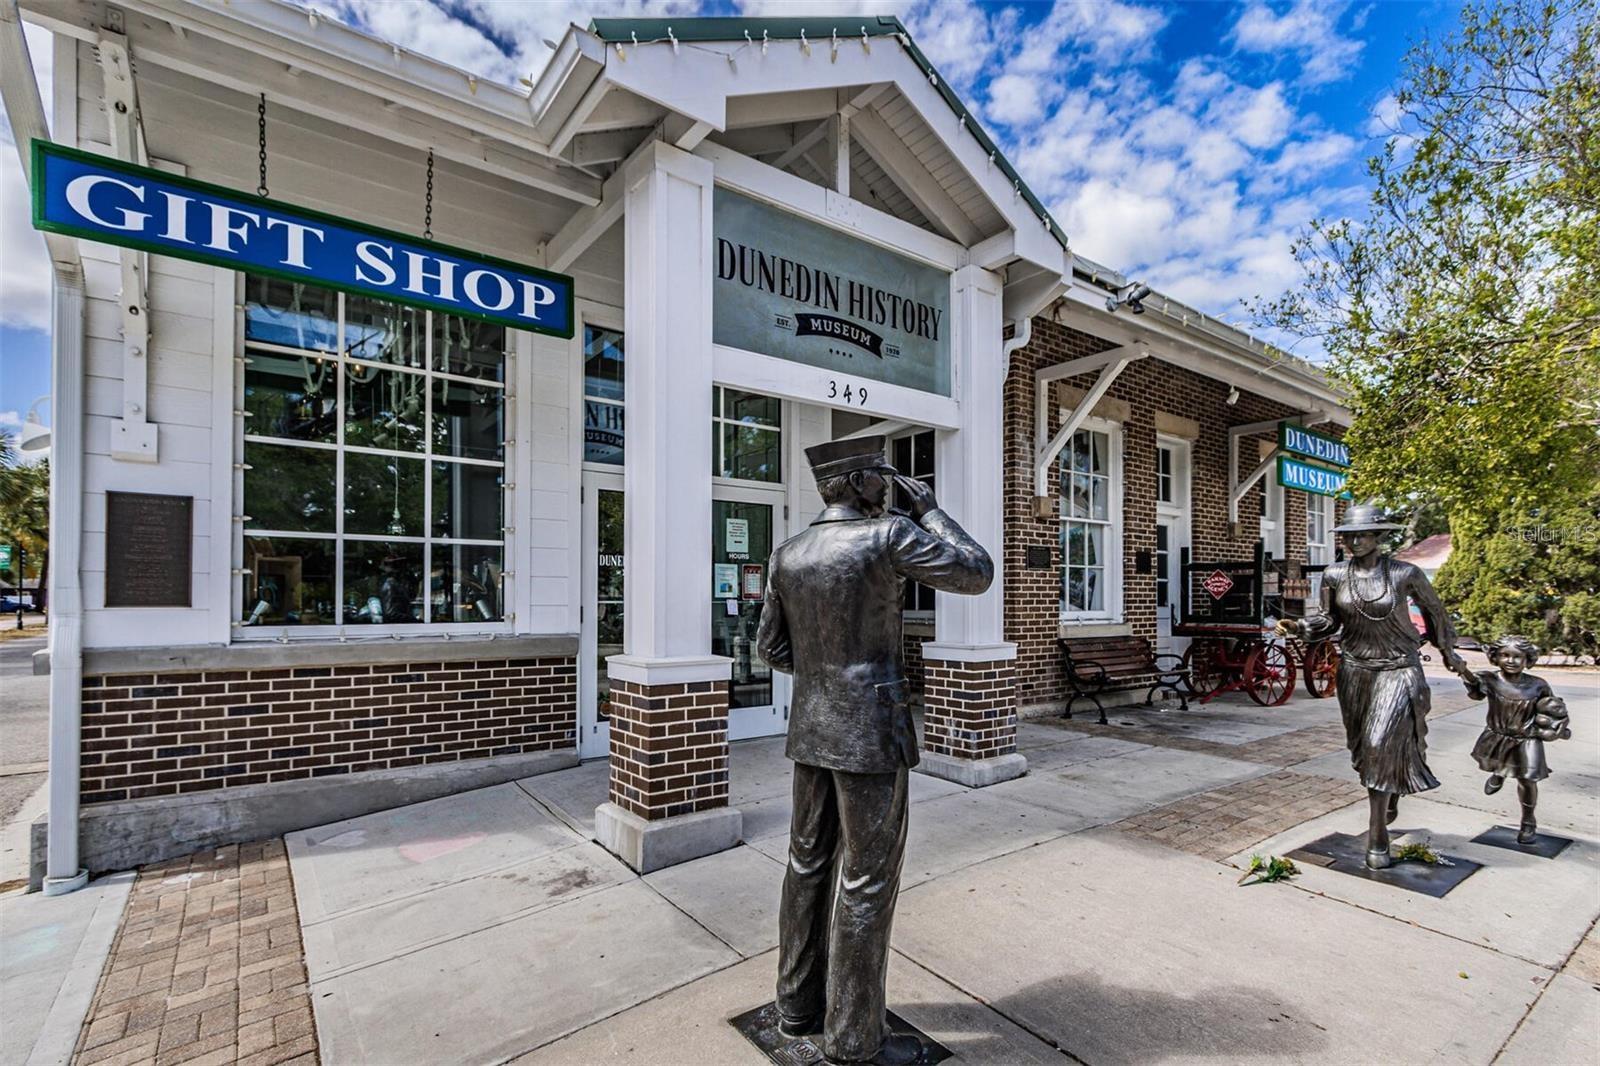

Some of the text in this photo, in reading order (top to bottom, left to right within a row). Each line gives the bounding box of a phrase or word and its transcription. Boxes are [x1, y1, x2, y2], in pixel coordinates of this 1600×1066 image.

[66, 175, 556, 320] GIFT SHOP
[718, 238, 942, 341] DUNEDIN HISTORY
[810, 318, 871, 345] MUSEUM
[828, 380, 868, 406] 349
[1285, 427, 1349, 464] DUNEDIN
